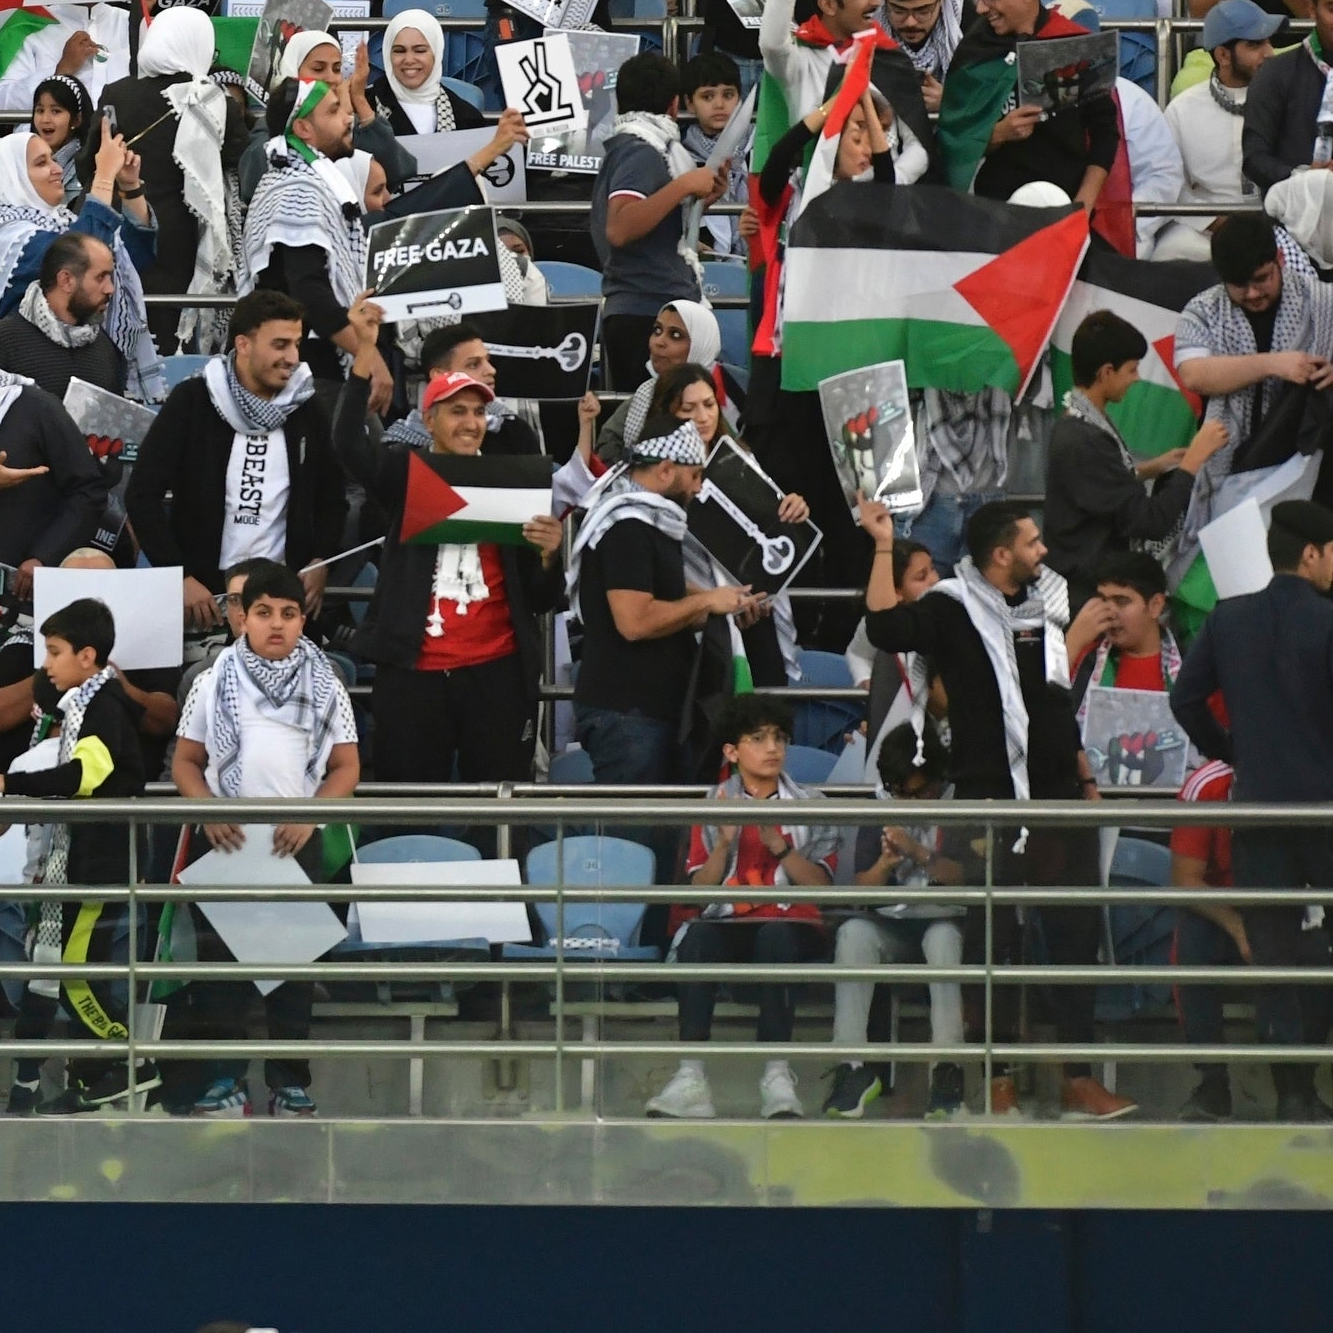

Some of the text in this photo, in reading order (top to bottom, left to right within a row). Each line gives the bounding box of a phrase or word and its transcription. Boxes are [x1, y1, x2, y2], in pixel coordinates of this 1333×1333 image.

[528, 152, 602, 169] FREE PALEST
[373, 236, 490, 271] FREE GAZA
[238, 440, 268, 517] BEAST
[234, 515, 261, 527] MODE
